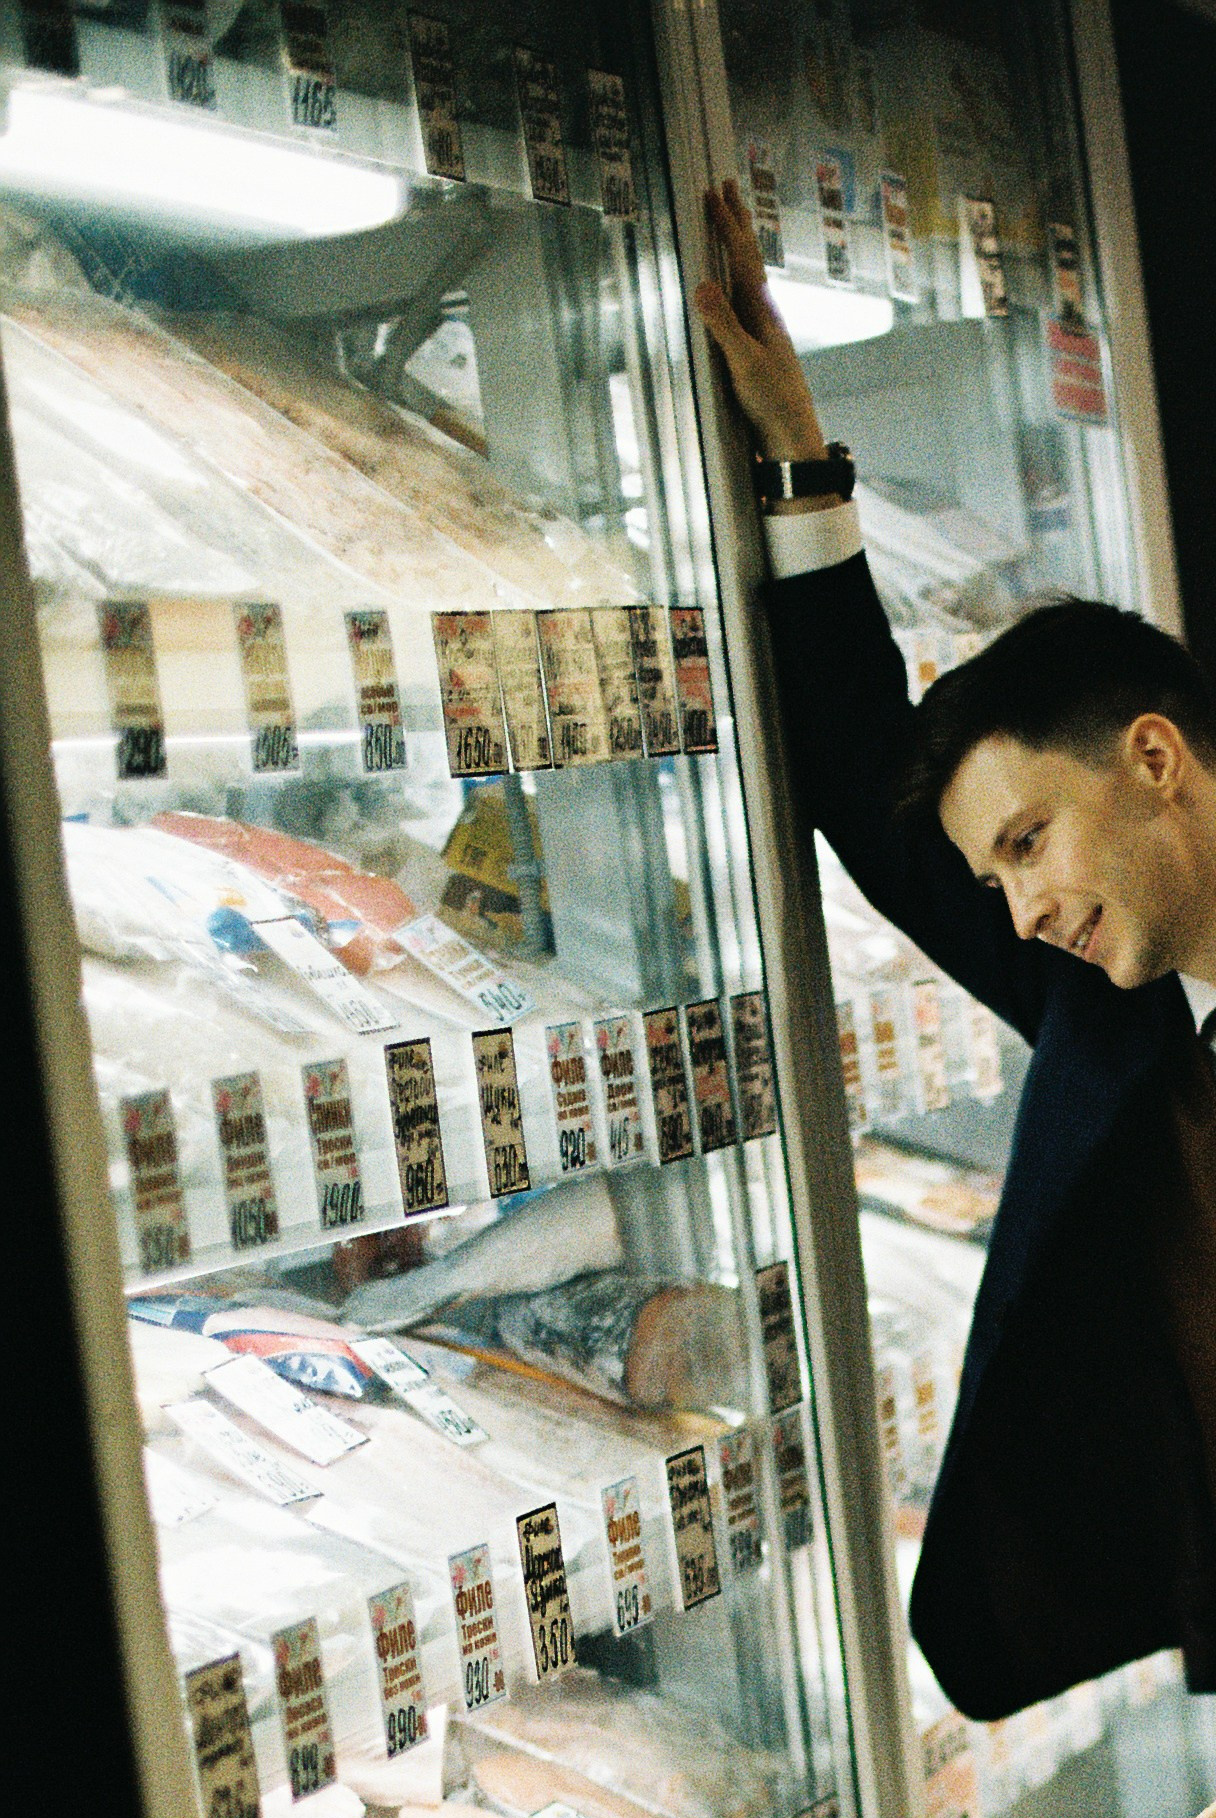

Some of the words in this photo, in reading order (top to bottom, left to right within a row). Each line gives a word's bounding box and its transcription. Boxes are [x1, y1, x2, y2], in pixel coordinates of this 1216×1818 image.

[454, 1580, 494, 1620] Филе
[376, 1619, 417, 1663] Филе
[461, 1617, 495, 1641] Трески
[538, 1617, 568, 1674] 350
[279, 1656, 322, 1697] Филе
[382, 1658, 417, 1685] Трески
[465, 1656, 490, 1709] 930
[387, 1705, 417, 1757] 990
